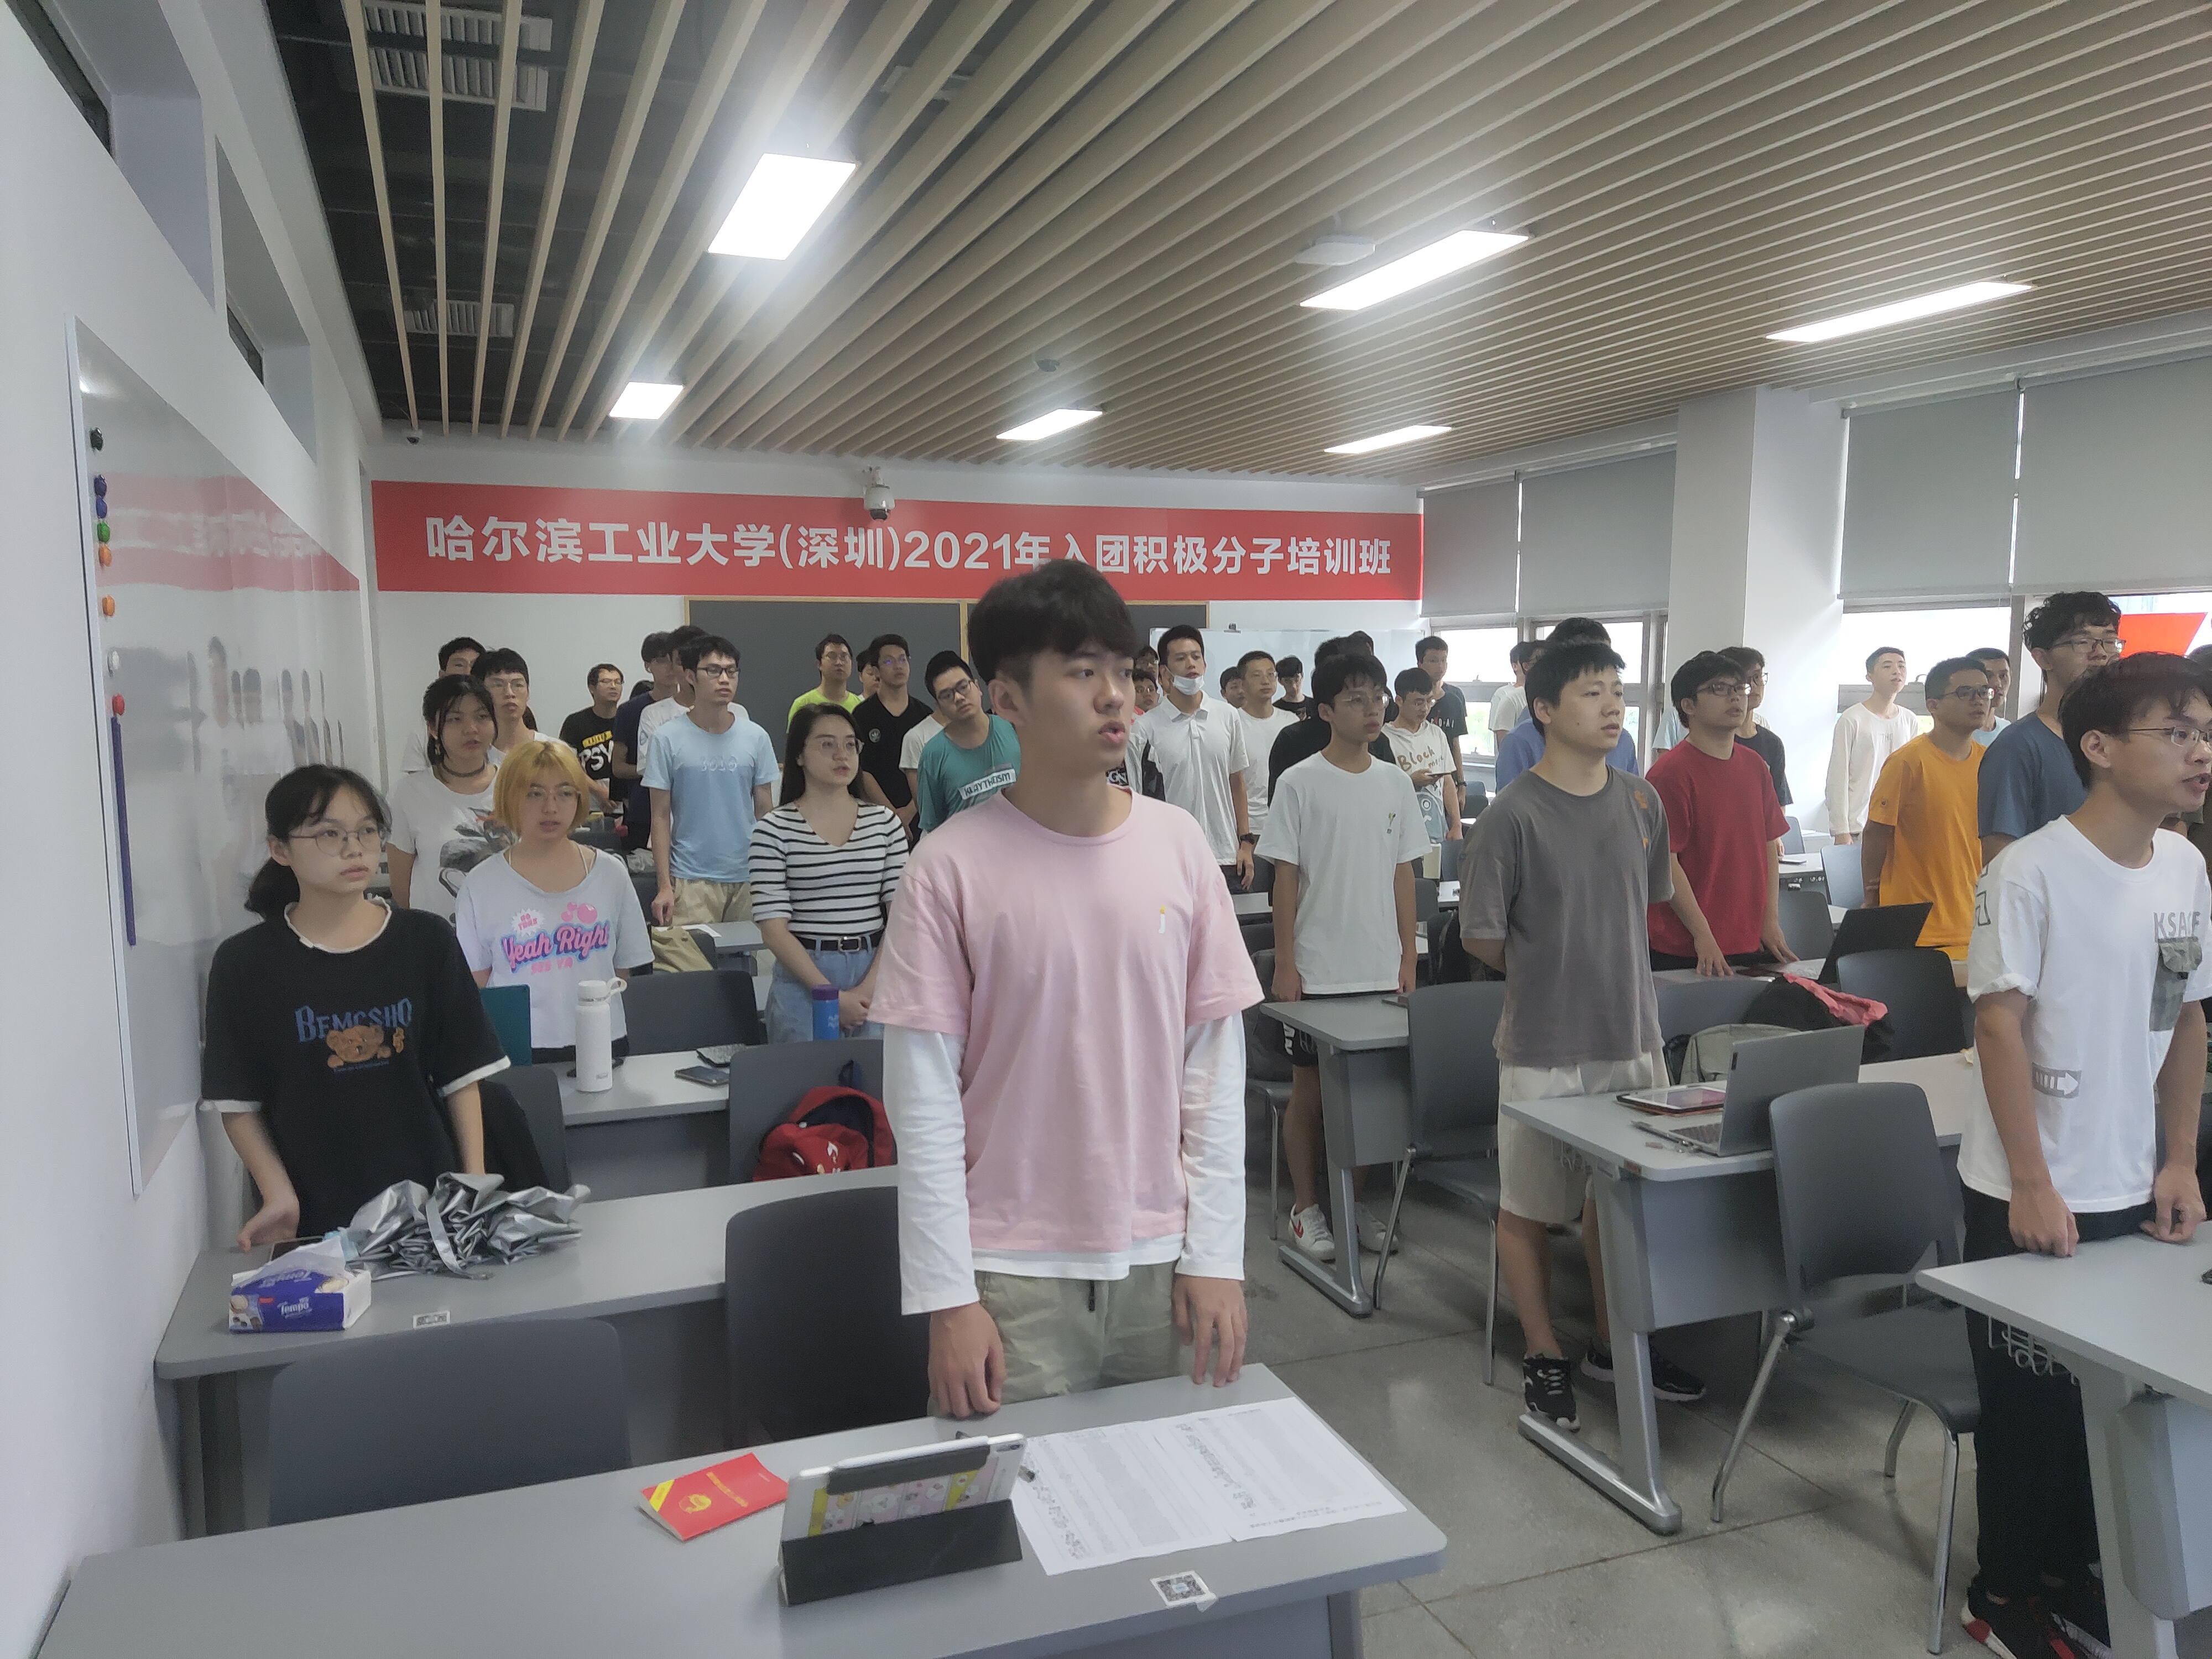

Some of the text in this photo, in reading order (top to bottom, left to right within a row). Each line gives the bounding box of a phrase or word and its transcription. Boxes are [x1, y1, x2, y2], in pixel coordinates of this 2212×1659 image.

[426, 515, 1391, 576] 哈尔滨工业大学(深圳)2021年入团积极分子培训班
[501, 931, 554, 973] Yeah
